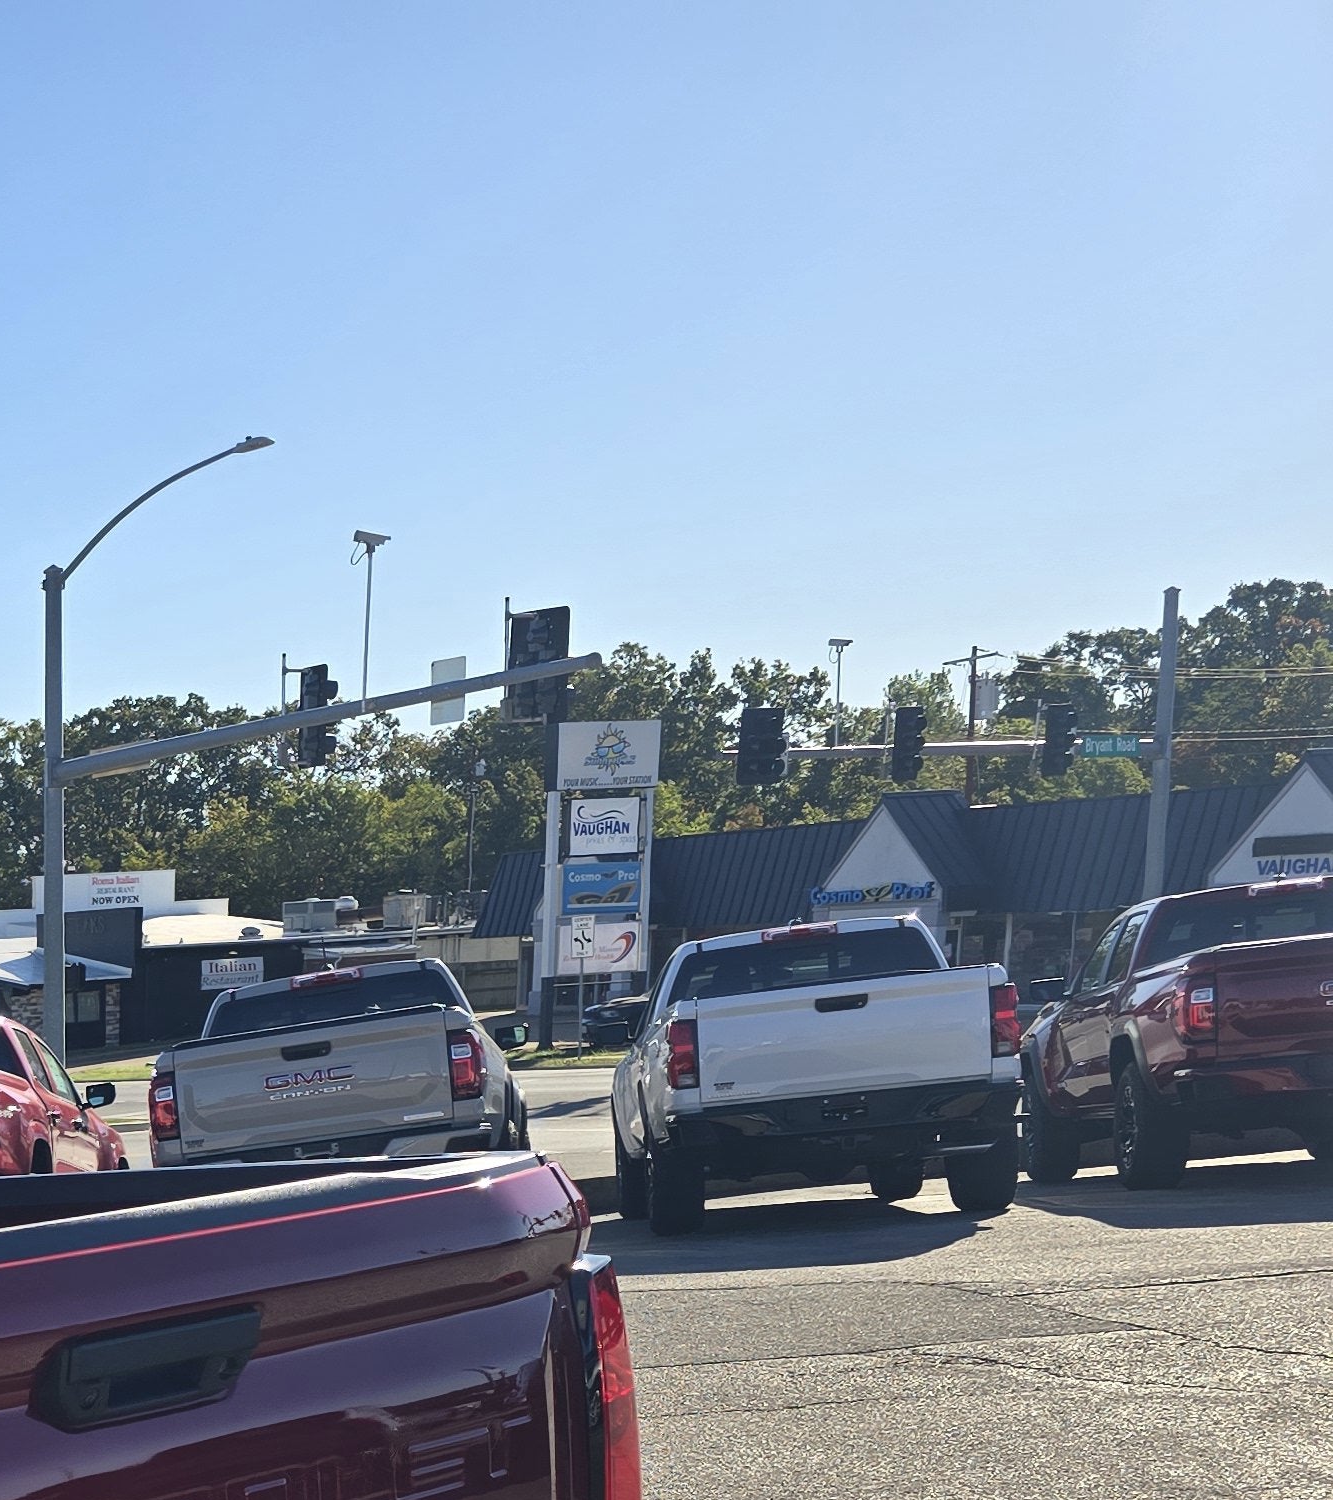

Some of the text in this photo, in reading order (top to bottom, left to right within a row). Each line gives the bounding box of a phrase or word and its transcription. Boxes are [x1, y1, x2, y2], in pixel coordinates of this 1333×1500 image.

[1086, 737, 1136, 755] Bryant Road
[573, 821, 630, 837] VAUGHAN
[1257, 857, 1333, 876] VAUGHA
[92, 875, 140, 885] Roma Italian
[568, 870, 640, 883] Cosmo Prof
[92, 895, 140, 906] NOW OPEN
[810, 881, 935, 905] Cosmo Prof
[209, 960, 257, 974] Italian
[202, 974, 259, 986] Restaurant
[264, 1065, 356, 1092] GMC
[269, 1084, 352, 1101] CANYON
